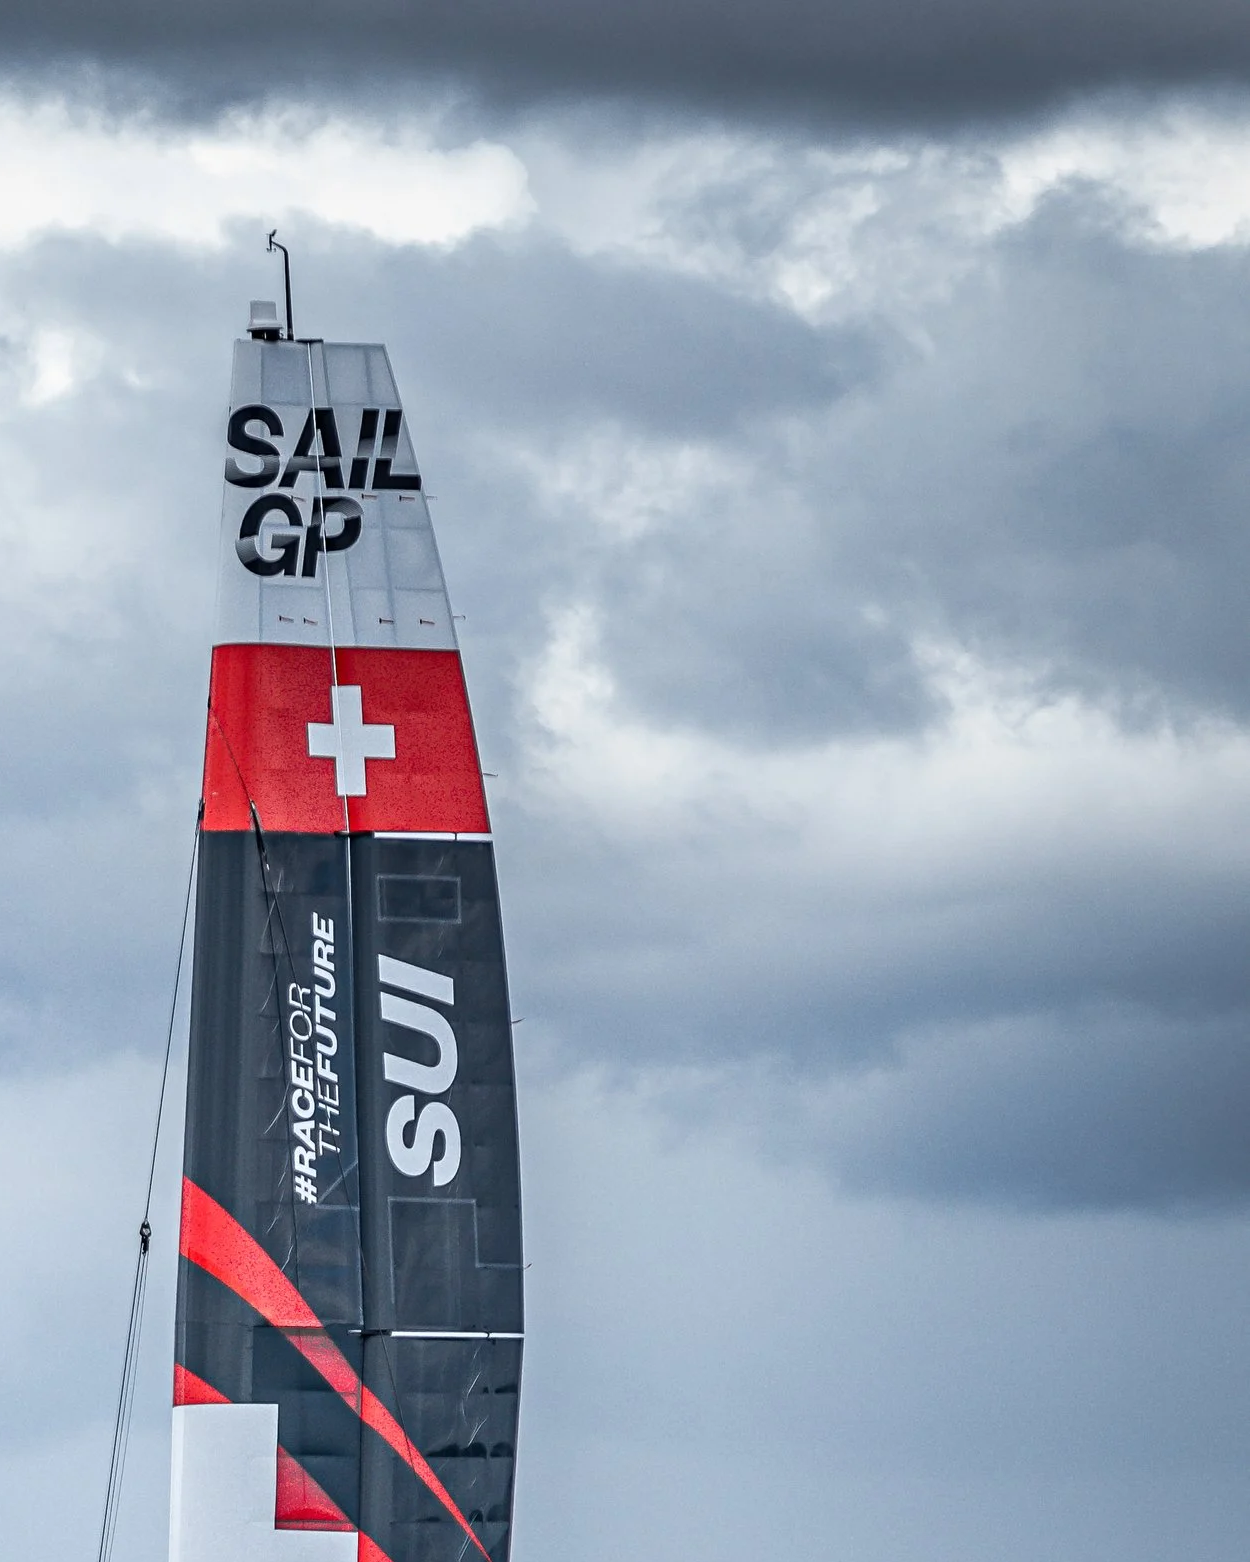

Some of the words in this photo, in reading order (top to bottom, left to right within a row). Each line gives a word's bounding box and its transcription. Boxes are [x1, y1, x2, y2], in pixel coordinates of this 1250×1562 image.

[224, 404, 422, 490] SAIL
[235, 492, 364, 578] GP
[378, 953, 461, 1188] SUI
